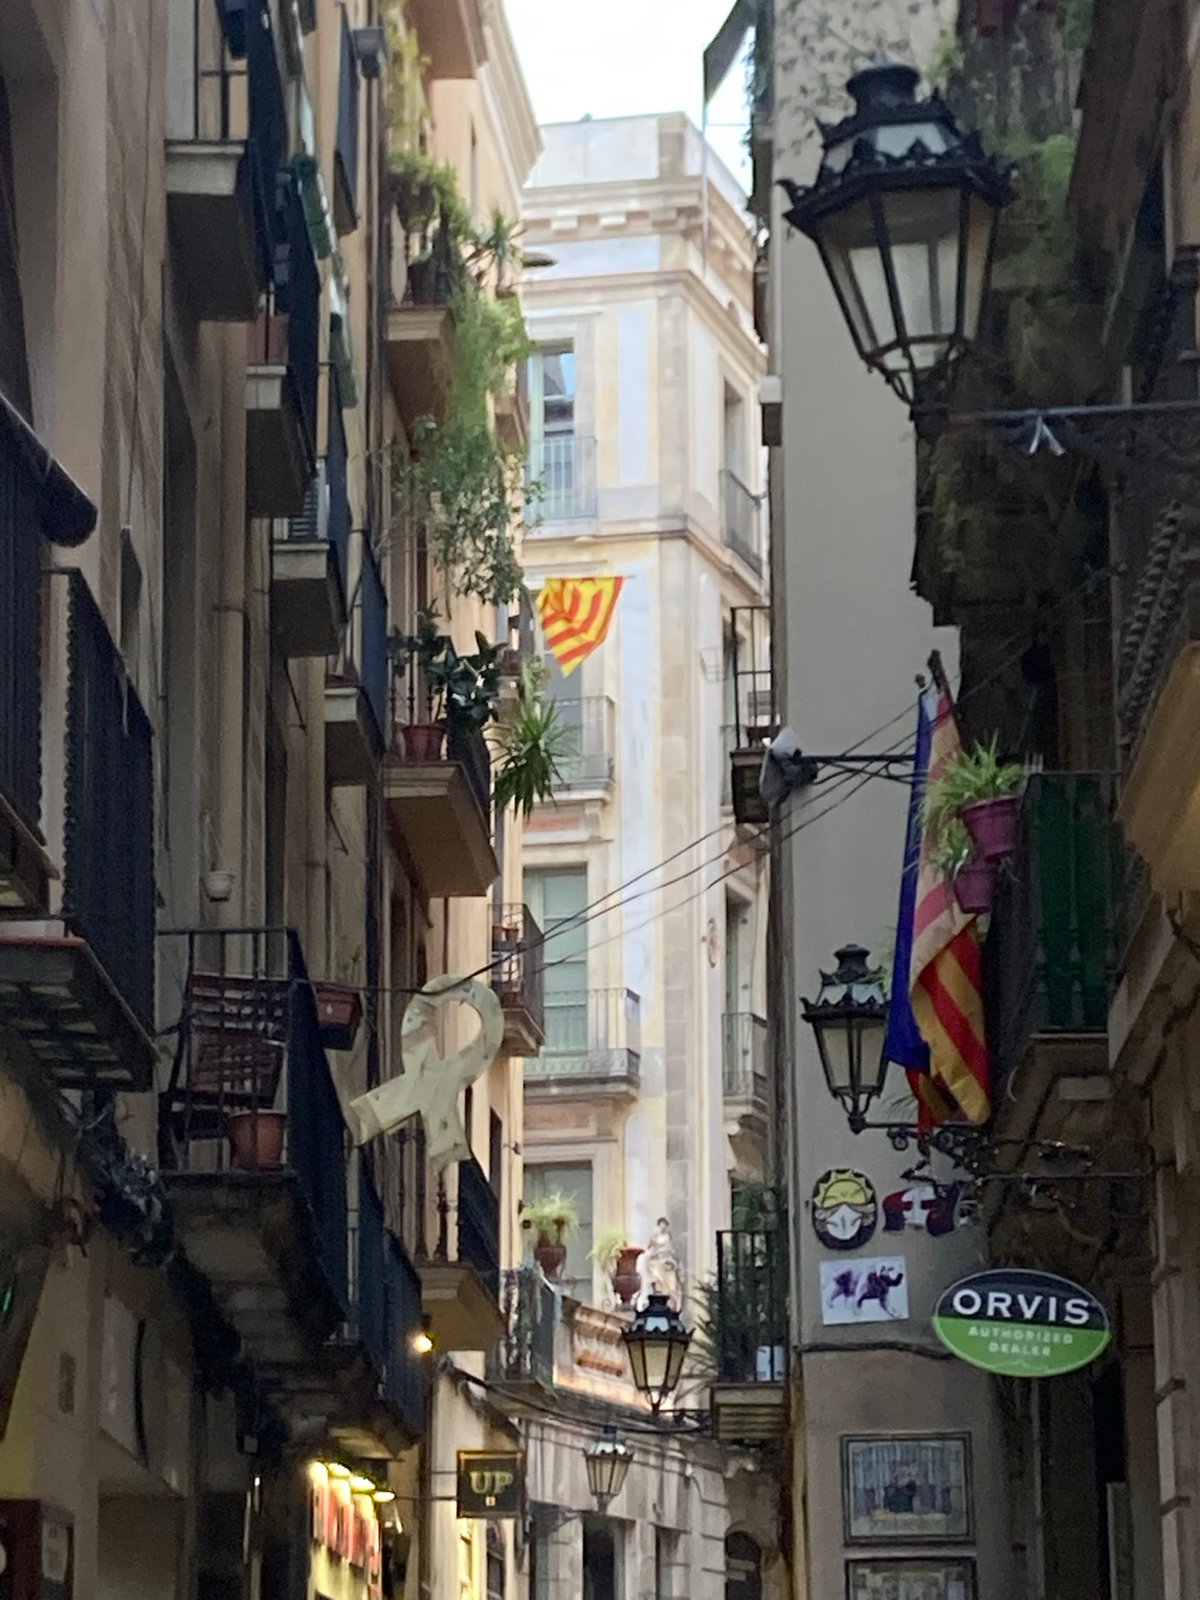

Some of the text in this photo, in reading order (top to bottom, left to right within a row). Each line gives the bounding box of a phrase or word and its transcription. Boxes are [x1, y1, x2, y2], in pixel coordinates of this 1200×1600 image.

[953, 1289, 1090, 1324] ORVIS
[968, 1326, 1073, 1344] AUTHORIZED
[989, 1343, 1051, 1357] DEALER
